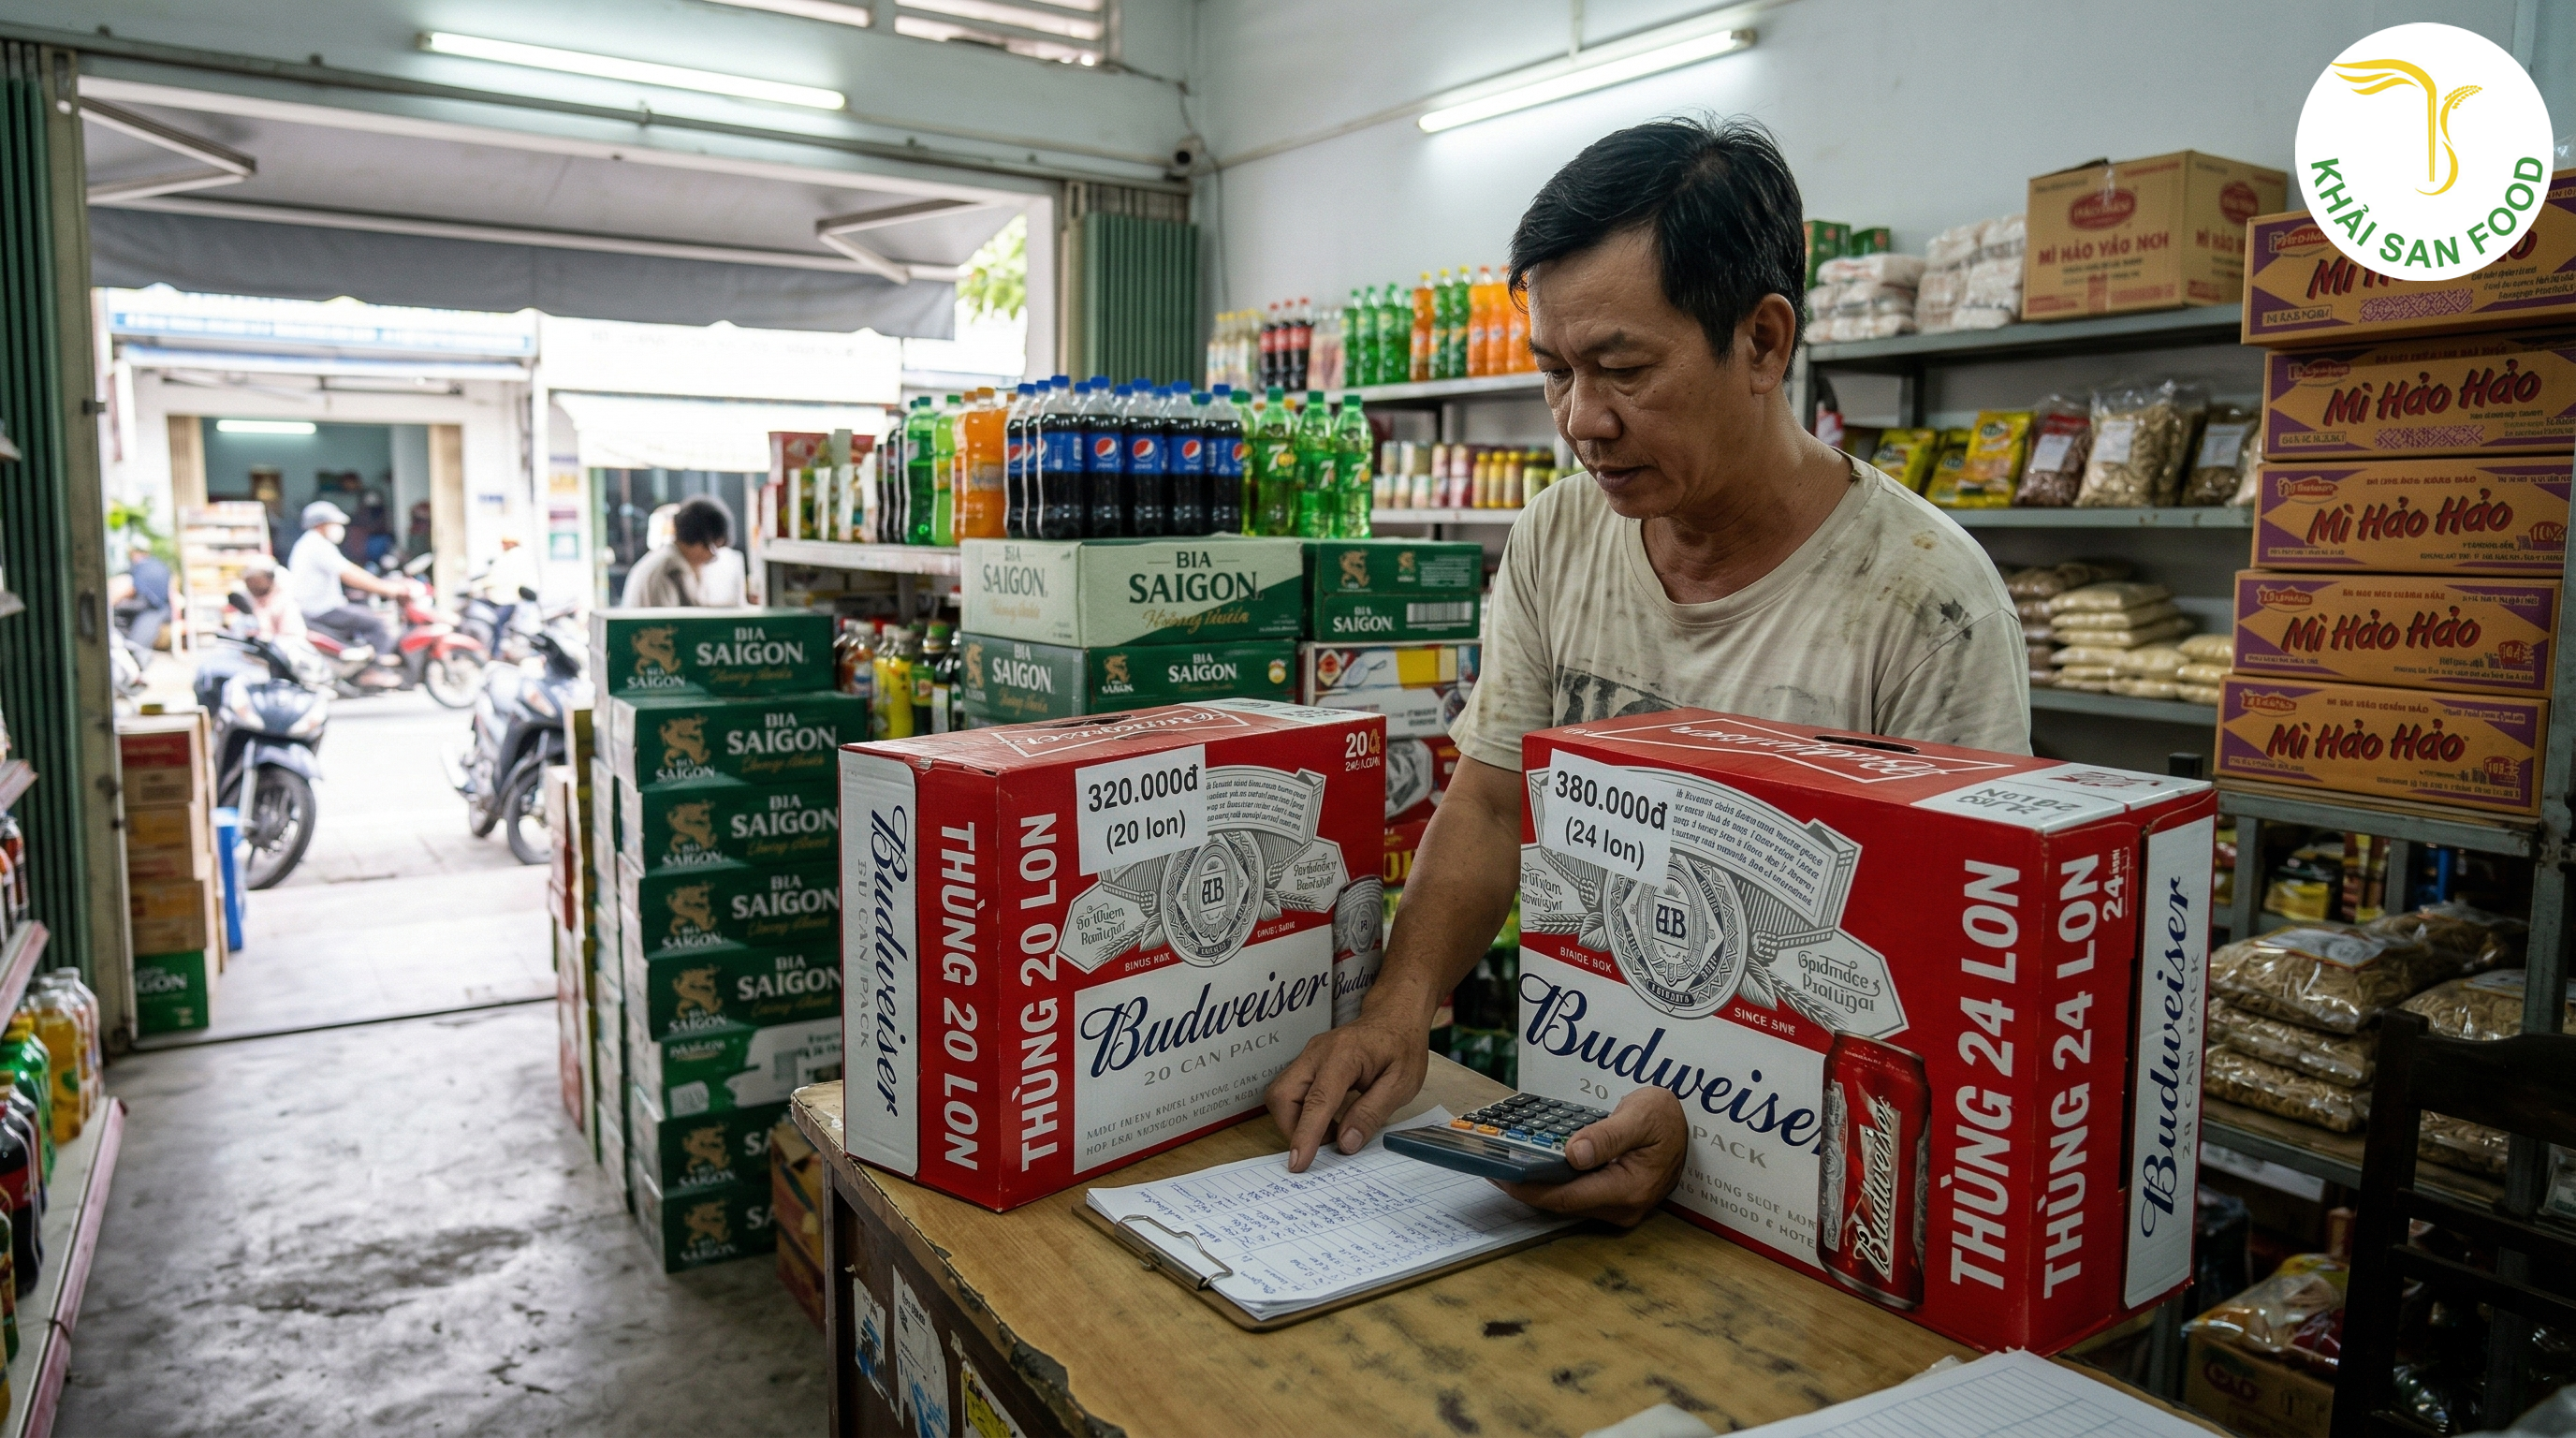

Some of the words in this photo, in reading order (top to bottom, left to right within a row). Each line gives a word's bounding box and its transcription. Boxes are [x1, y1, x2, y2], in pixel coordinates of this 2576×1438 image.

[2323, 382, 2373, 428] Mì
[2376, 371, 2453, 421] Hảo
[2458, 358, 2542, 410] Hảo
[2305, 503, 2354, 546] Mì
[2357, 495, 2430, 542] Hảo
[2435, 487, 2514, 536] Hảo
[983, 564, 1046, 598] SAIGON
[1176, 550, 1213, 568] BIA
[1129, 571, 1258, 604] SAIGON
[735, 627, 767, 642] BIA
[1333, 615, 1394, 633] SAIGON
[2281, 611, 2328, 653] Mì
[2331, 608, 2401, 653] Hảo
[2406, 605, 2481, 650] Hảo
[695, 640, 805, 667] SAIGON
[992, 657, 1052, 694] SAIGON
[1168, 663, 1237, 683] SAIGON
[726, 726, 837, 756] SAIGON
[765, 712, 798, 727] BIA
[2266, 722, 2312, 760] Mì
[2315, 718, 2384, 762] Hảo
[2390, 718, 2466, 763] Hảo
[769, 795, 802, 811] BIA
[1088, 763, 1199, 813] 320.000đ
[1555, 770, 1668, 831] 380.000đ
[730, 806, 840, 841] SAIGON
[1106, 819, 1139, 854] (20
[1147, 809, 1187, 838] lon)
[1565, 815, 1597, 849] (24
[1604, 828, 1645, 872] lon)
[770, 874, 802, 890] BIA
[1019, 813, 1058, 910] LON
[731, 887, 841, 919] SAIGON
[942, 821, 986, 986] THÙNG
[1961, 858, 2020, 985] LON
[2056, 853, 2100, 980] LON
[775, 955, 806, 971] BIA
[858, 908, 869, 962] CAN
[871, 804, 908, 1118] Budweiser
[1020, 922, 1058, 987] 20
[737, 966, 842, 1001] SAIGON
[2188, 952, 2200, 1034] PACK
[860, 976, 870, 1049] PACK
[944, 997, 978, 1063] 20
[1079, 970, 1330, 1078] Budweiser
[1734, 1007, 1768, 1027] SINCE
[1957, 995, 2014, 1078] 24
[2053, 990, 2094, 1071] 24
[1012, 997, 1059, 1172] THÙNG
[1144, 1066, 1172, 1087] 20
[1180, 1049, 1222, 1074] CAN
[1229, 1031, 1281, 1059] PACK
[2141, 875, 2189, 1239] Budweiser
[2185, 1049, 2195, 1109] CAN
[944, 1072, 979, 1171] LON
[1579, 1077, 1610, 1101] 20
[1692, 1124, 1767, 1169] PACK
[1940, 1085, 2012, 1291] THÙNG
[2037, 1081, 2090, 1299] THÙNG
